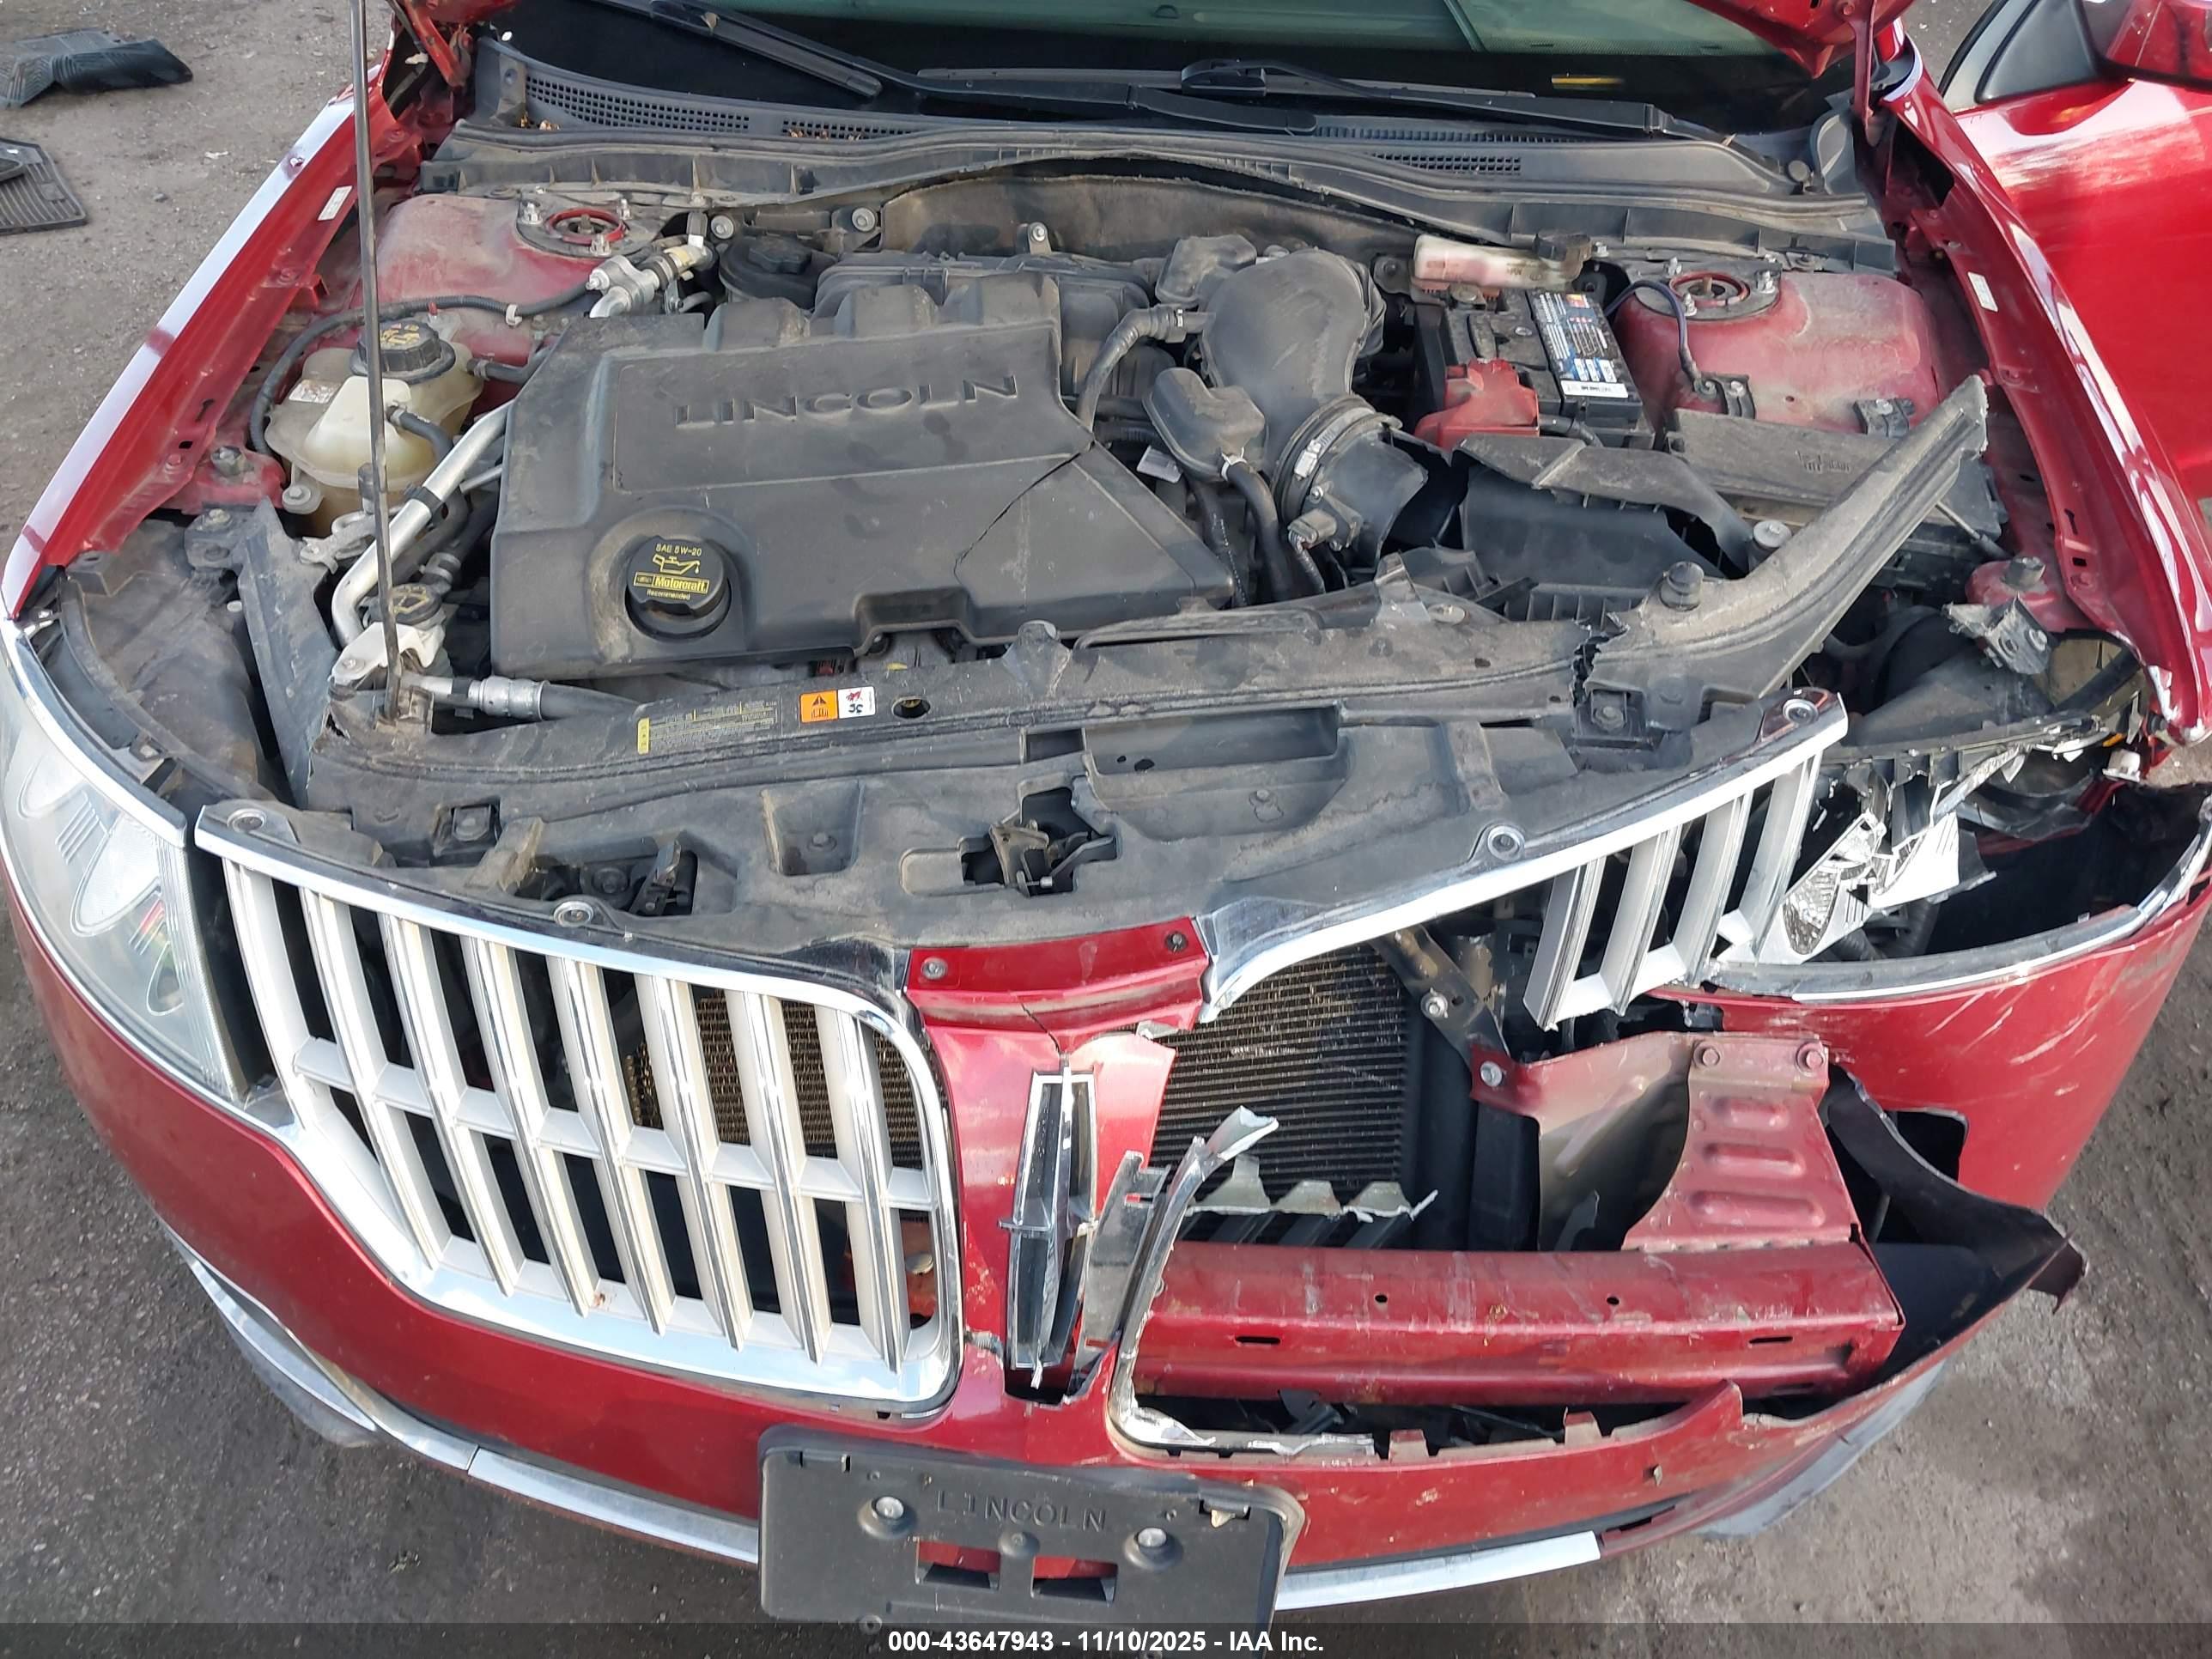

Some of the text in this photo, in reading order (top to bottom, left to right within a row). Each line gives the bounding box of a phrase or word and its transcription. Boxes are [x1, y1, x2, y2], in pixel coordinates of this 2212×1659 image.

[675, 374, 1018, 428] LINCOLN
[655, 544, 702, 556] SAE 5W-20
[655, 577, 706, 592] Motorcraft
[647, 588, 691, 600] Recommended
[936, 1490, 1106, 1533] LINCOLN
